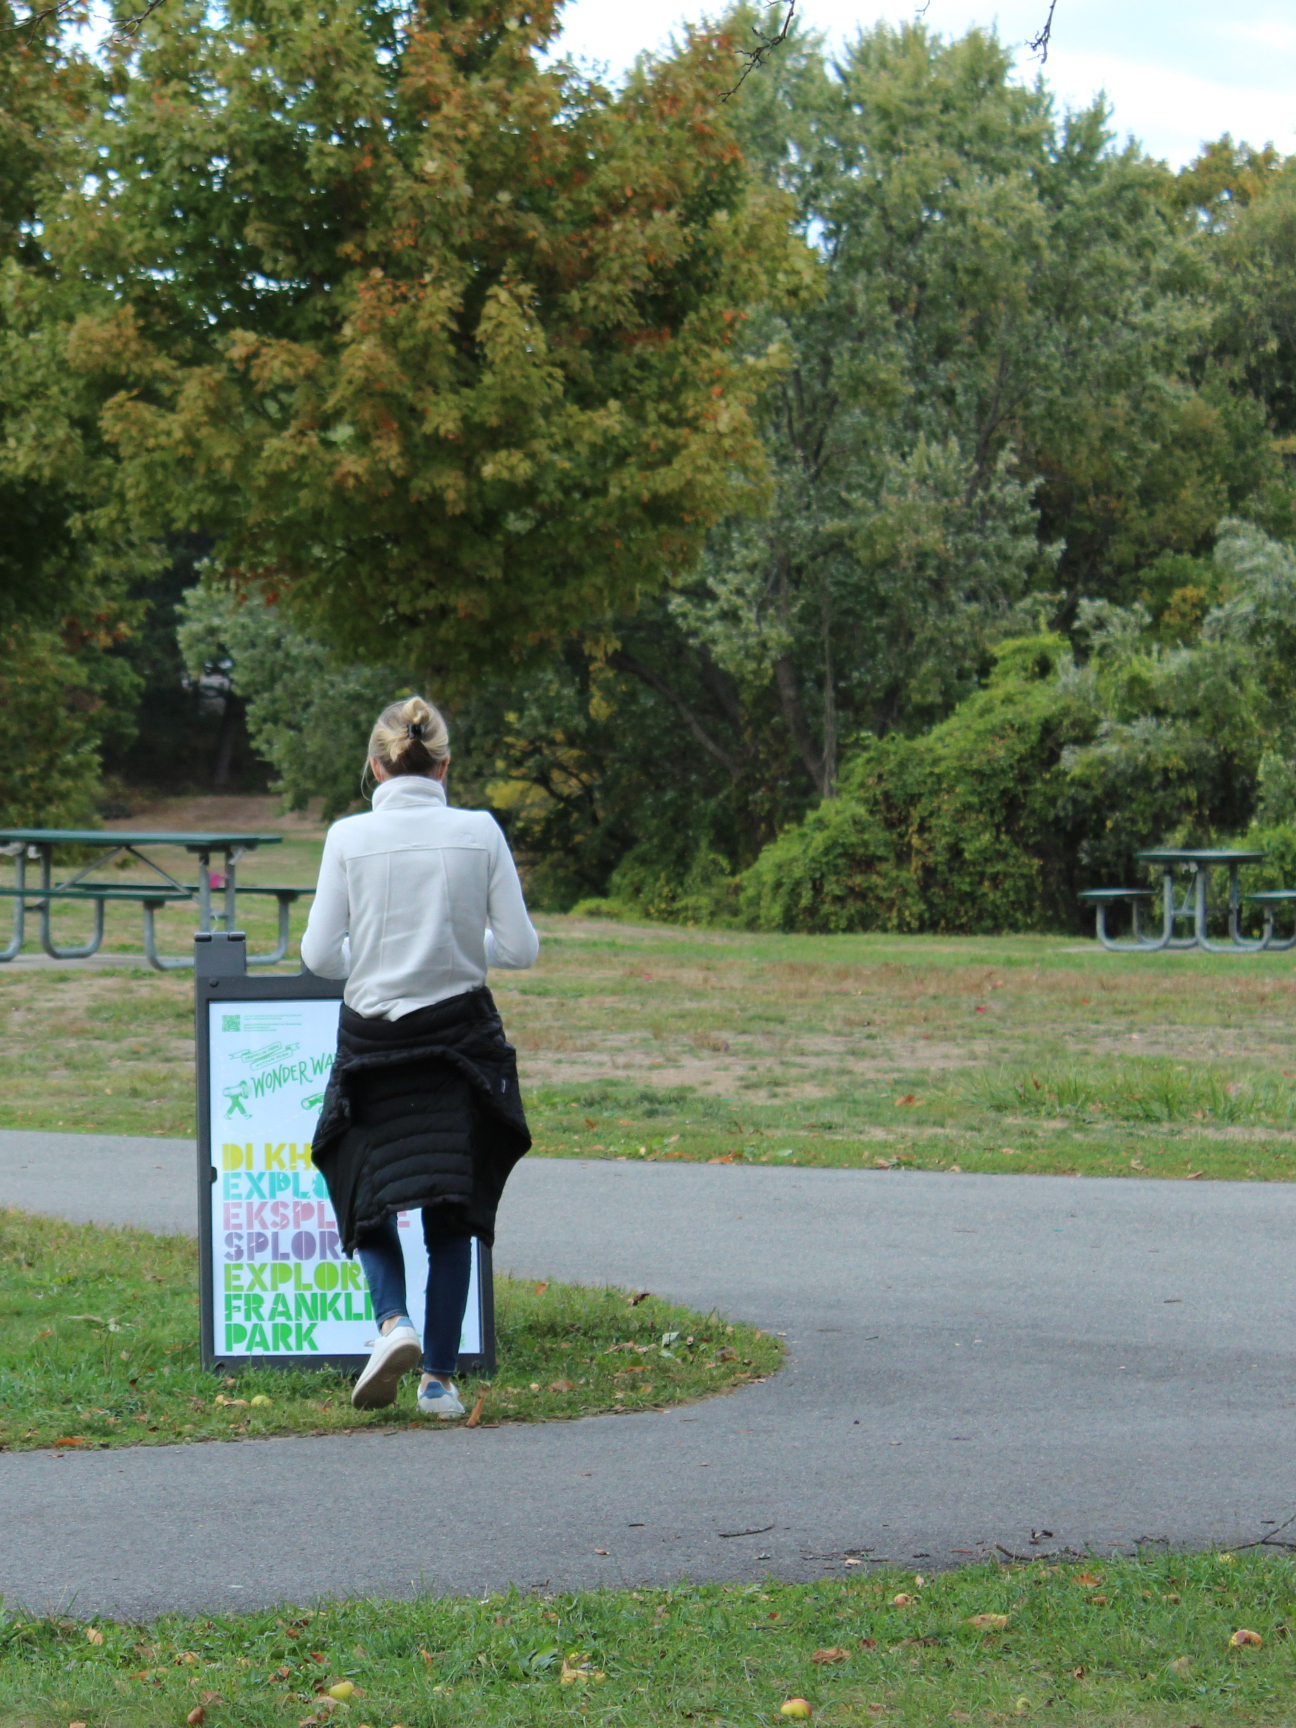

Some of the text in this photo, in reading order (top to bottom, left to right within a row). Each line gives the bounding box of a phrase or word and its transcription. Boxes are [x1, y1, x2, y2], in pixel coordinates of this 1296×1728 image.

[250, 1061, 313, 1098] WONDER
[310, 1052, 339, 1076] WA
[264, 1143, 318, 1171] KH
[223, 1201, 410, 1231] EKSPL
[224, 1231, 359, 1261] SPLOR
[224, 1262, 371, 1292] EXPLOR
[225, 1293, 376, 1322] FRANKLI
[225, 1323, 319, 1352] PARK
